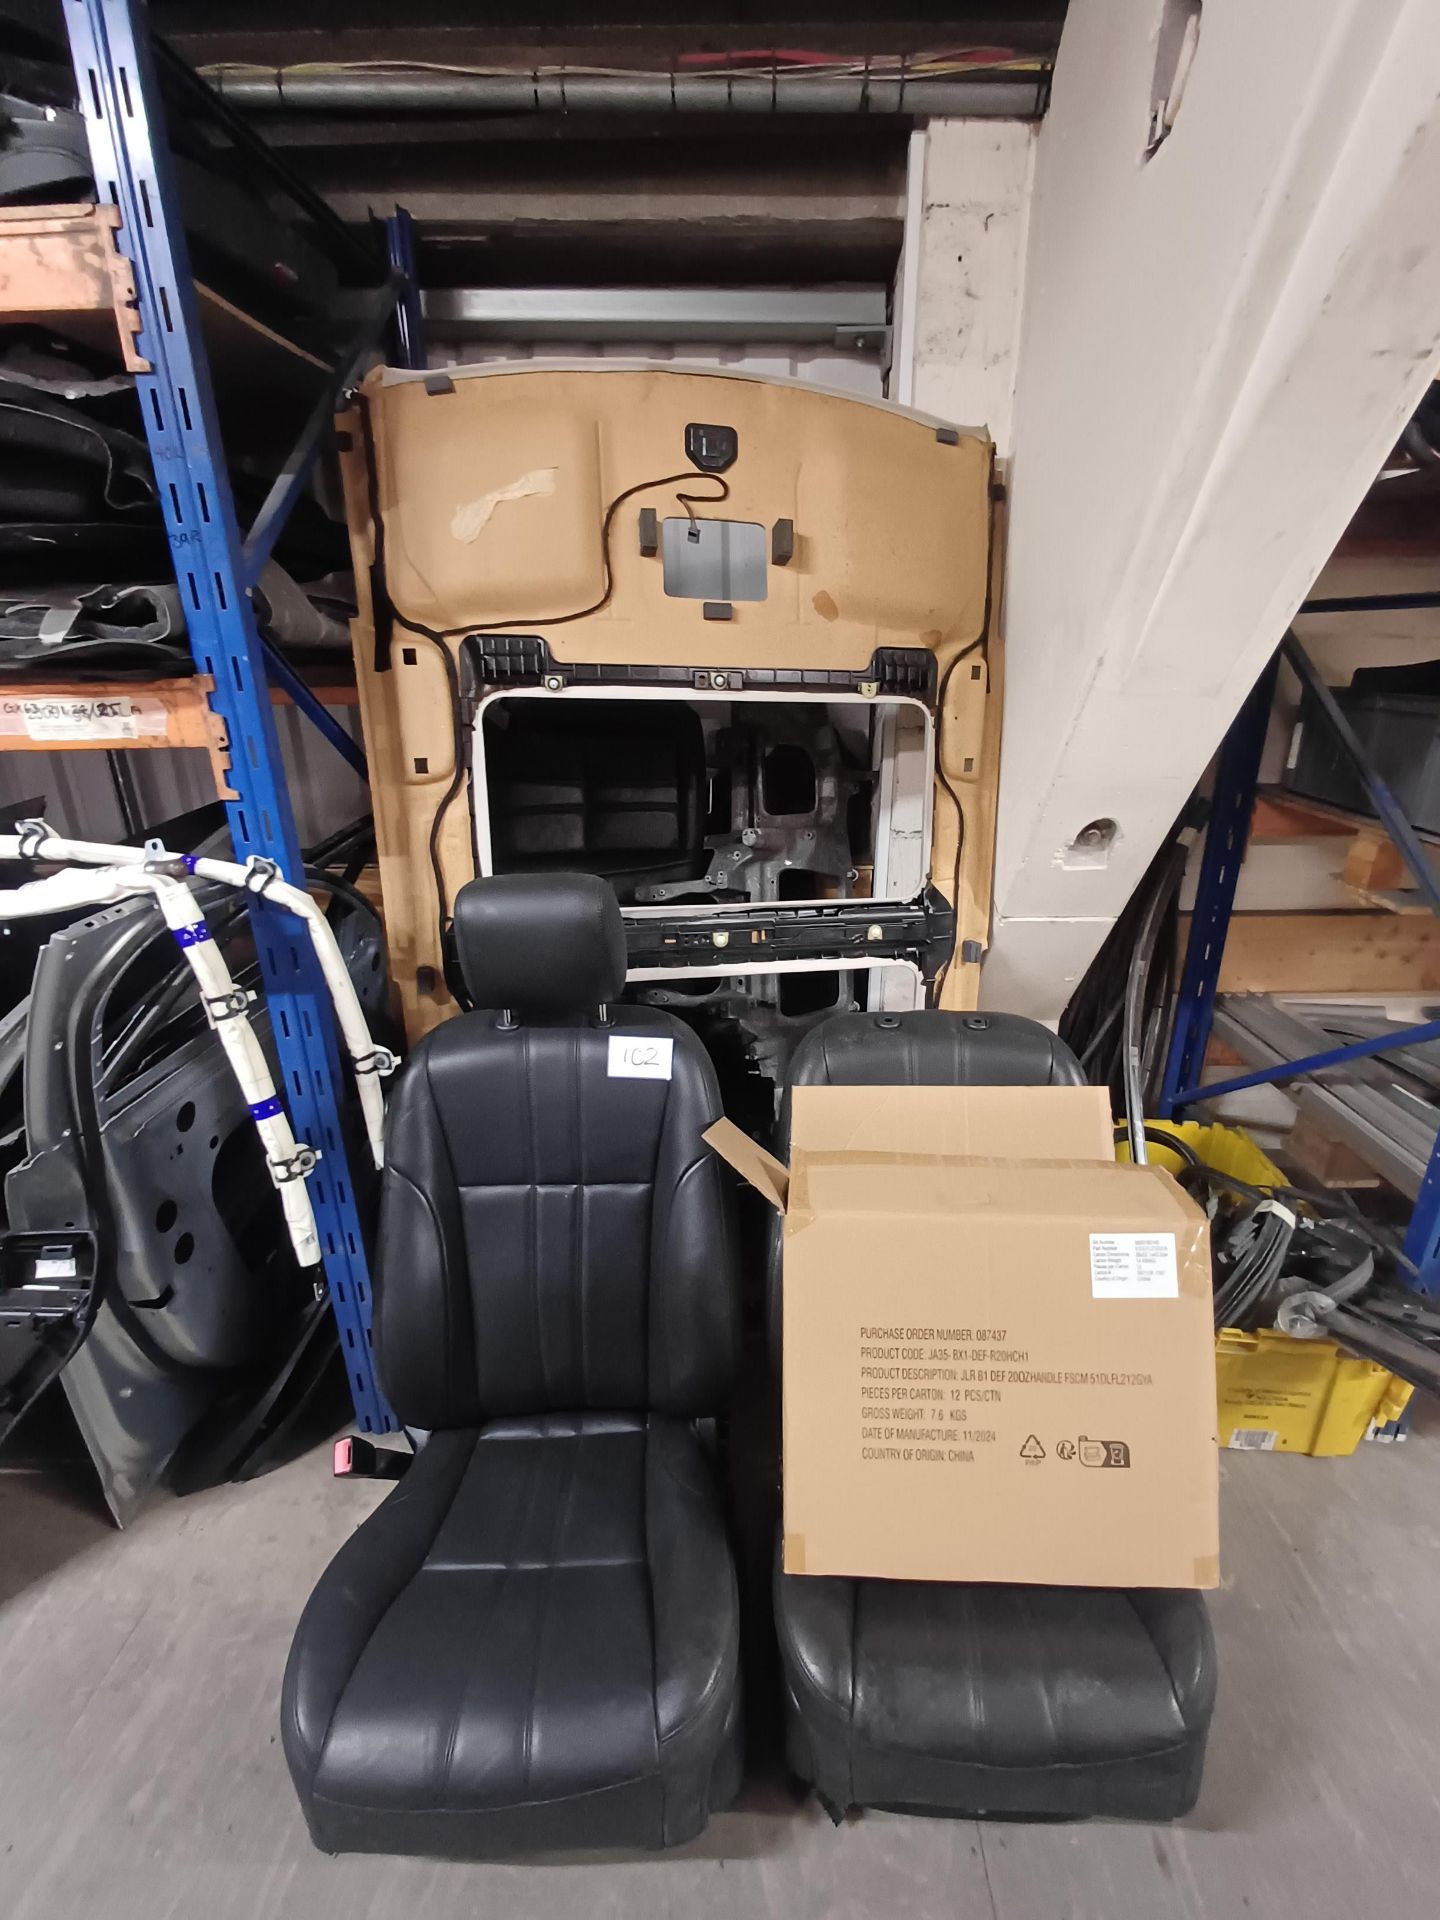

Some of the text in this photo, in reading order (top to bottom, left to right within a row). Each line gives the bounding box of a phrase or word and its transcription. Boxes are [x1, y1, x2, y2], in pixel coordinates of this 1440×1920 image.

[624, 1047, 660, 1066] 102
[860, 1327, 1007, 1342] PURCHASE ORDER NUMBER: 087437
[860, 1347, 900, 1360] PRODUCT
[901, 1348, 926, 1361] CODE:
[861, 1367, 900, 1380] PRODUCT
[902, 1368, 957, 1381] DESCRIPTION:
[961, 1370, 976, 1382] JLR
[991, 1370, 1006, 1382] DEF
[861, 1387, 1002, 1402] PIECES PER CARTON: 12 PCS/CTN
[862, 1407, 968, 1422] GROSS WEIGHT: 7.6 KGS
[862, 1427, 997, 1442] DATE OF MANUFACTURE: 11/2024
[862, 1447, 975, 1462] COUNTRY OF ORIGIN: CHINA
